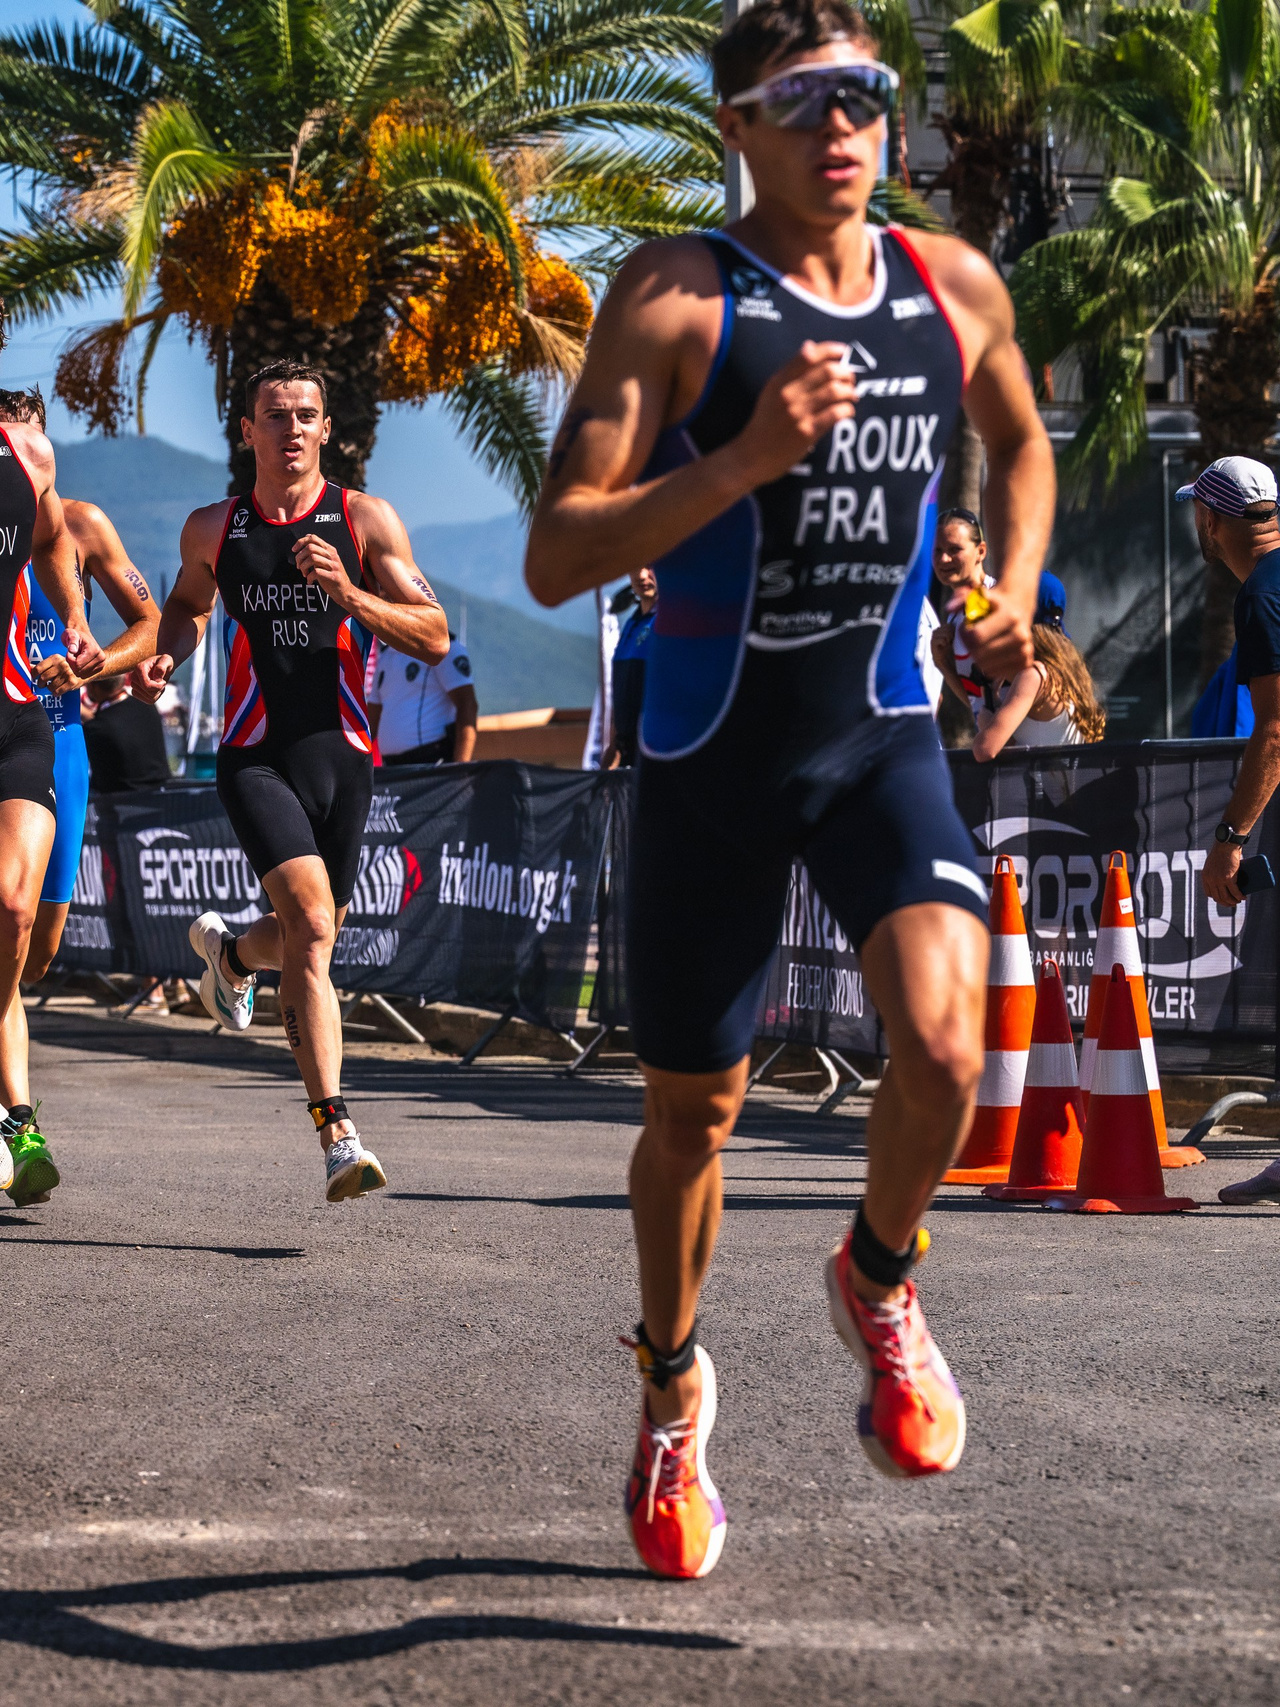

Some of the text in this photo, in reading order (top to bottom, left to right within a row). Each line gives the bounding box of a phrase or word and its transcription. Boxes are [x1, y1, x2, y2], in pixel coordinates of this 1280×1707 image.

[827, 413, 939, 474] ROUX
[794, 485, 889, 547] FRA
[241, 583, 330, 613] KARPEEV
[25, 618, 56, 642] ARDO
[272, 619, 309, 647] RUS
[139, 847, 262, 901] SPORTOTO
[1029, 947, 1094, 969] BAŞKANLIĞ
[786, 962, 864, 1019] FEDERASYONU
